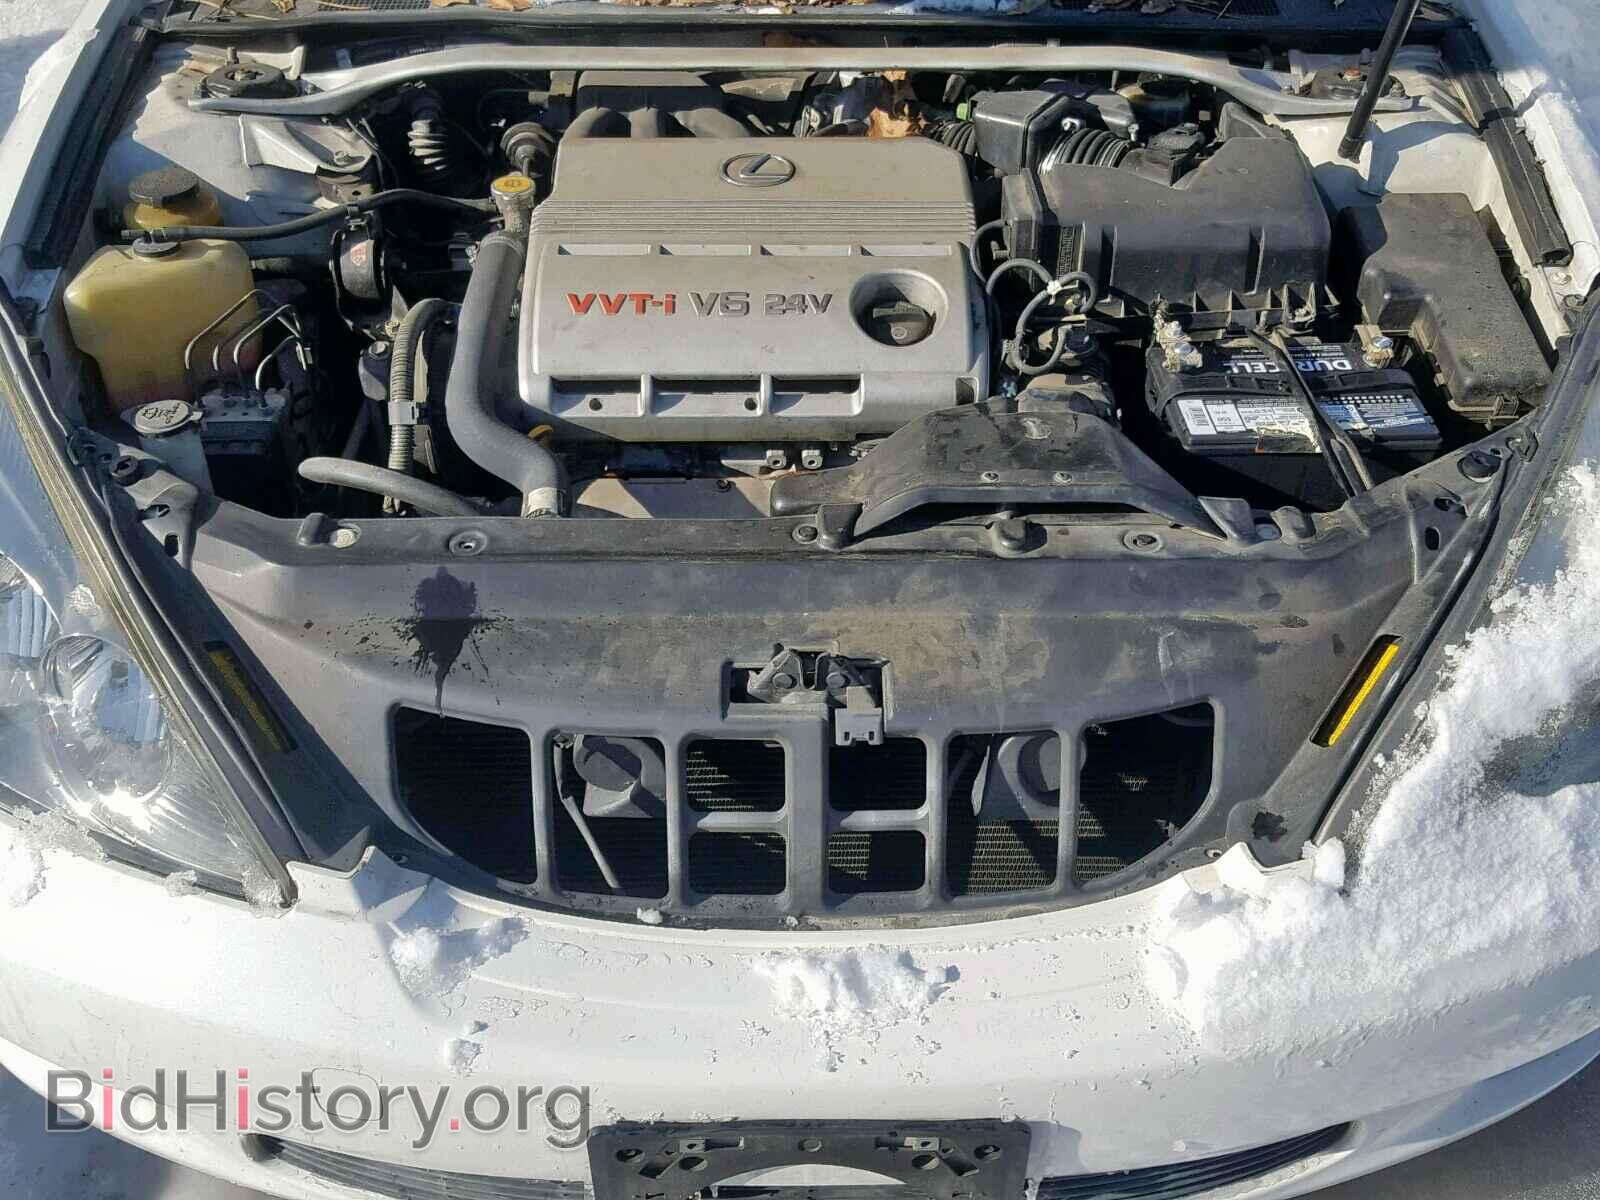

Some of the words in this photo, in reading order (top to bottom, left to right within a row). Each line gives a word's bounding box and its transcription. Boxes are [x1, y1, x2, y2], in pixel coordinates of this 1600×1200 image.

[567, 292, 677, 316] VVT-i
[688, 291, 750, 316] V6
[763, 292, 833, 316] 24V
[1223, 358, 1353, 374] DURCELL
